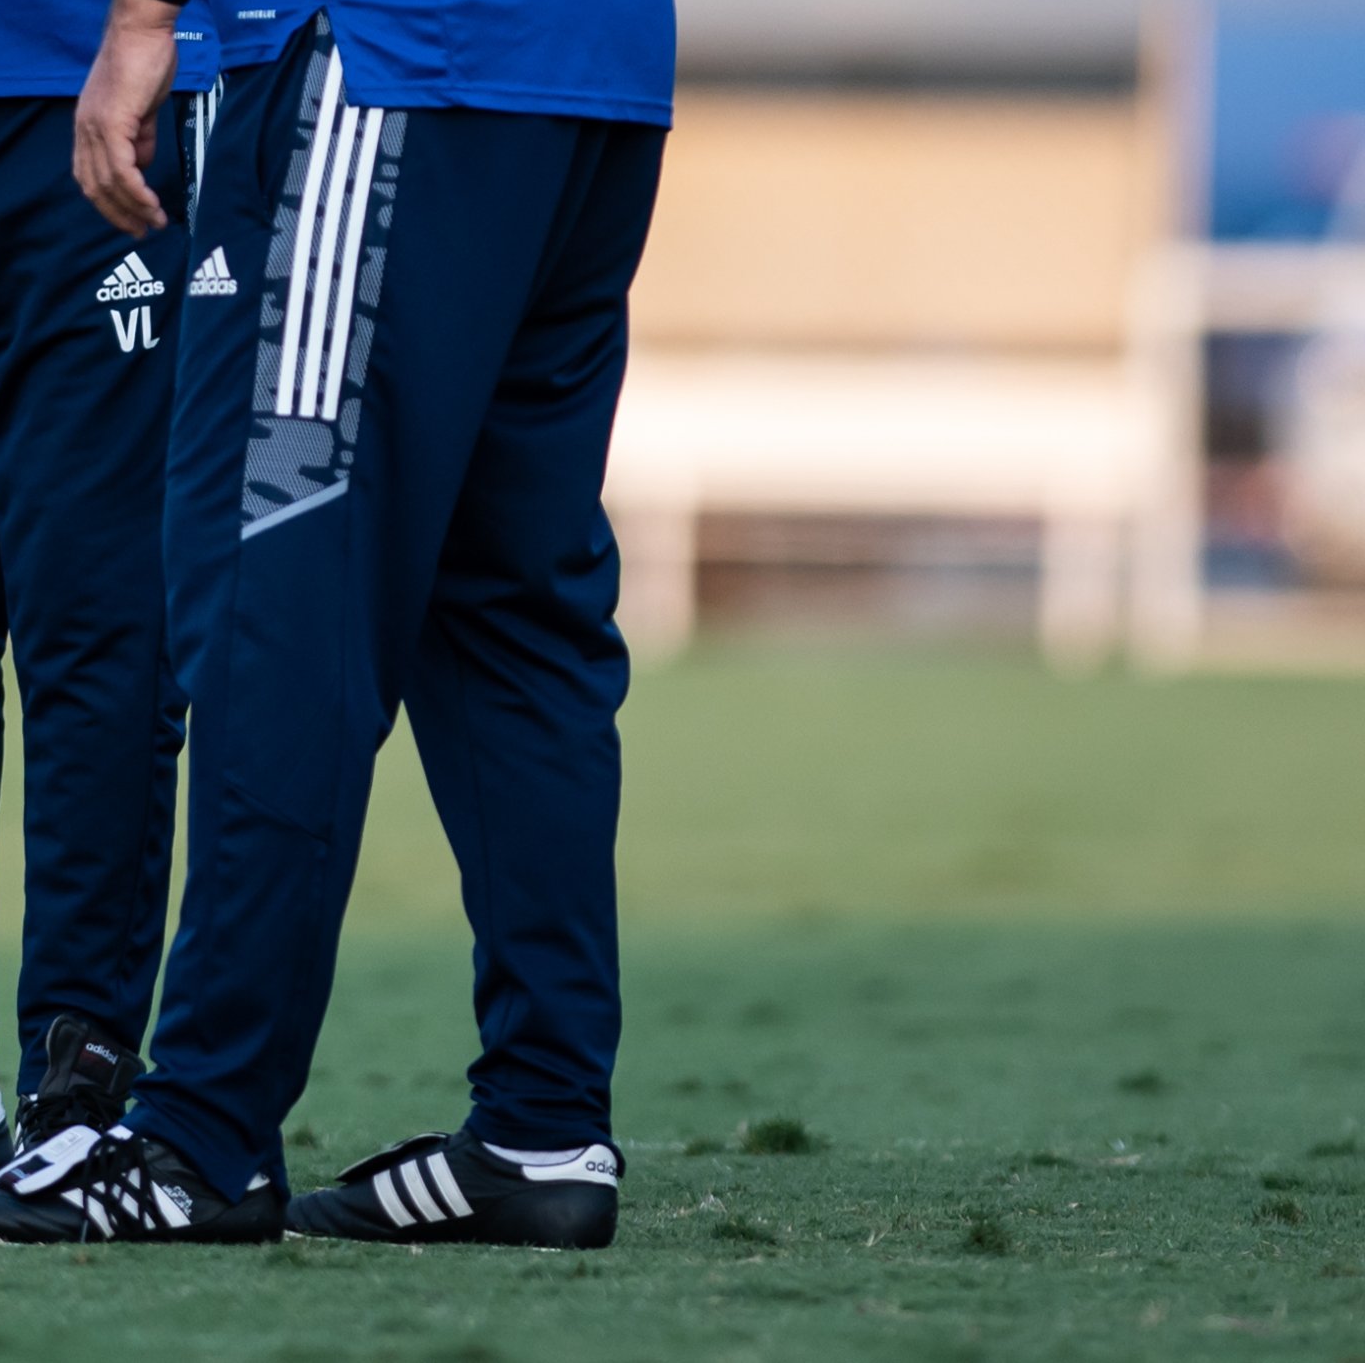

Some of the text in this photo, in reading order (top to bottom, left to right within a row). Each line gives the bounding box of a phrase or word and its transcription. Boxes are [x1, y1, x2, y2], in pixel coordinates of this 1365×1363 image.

[96, 280, 166, 302] adidas
[190, 278, 238, 296] adidas
[110, 305, 161, 353] VL
